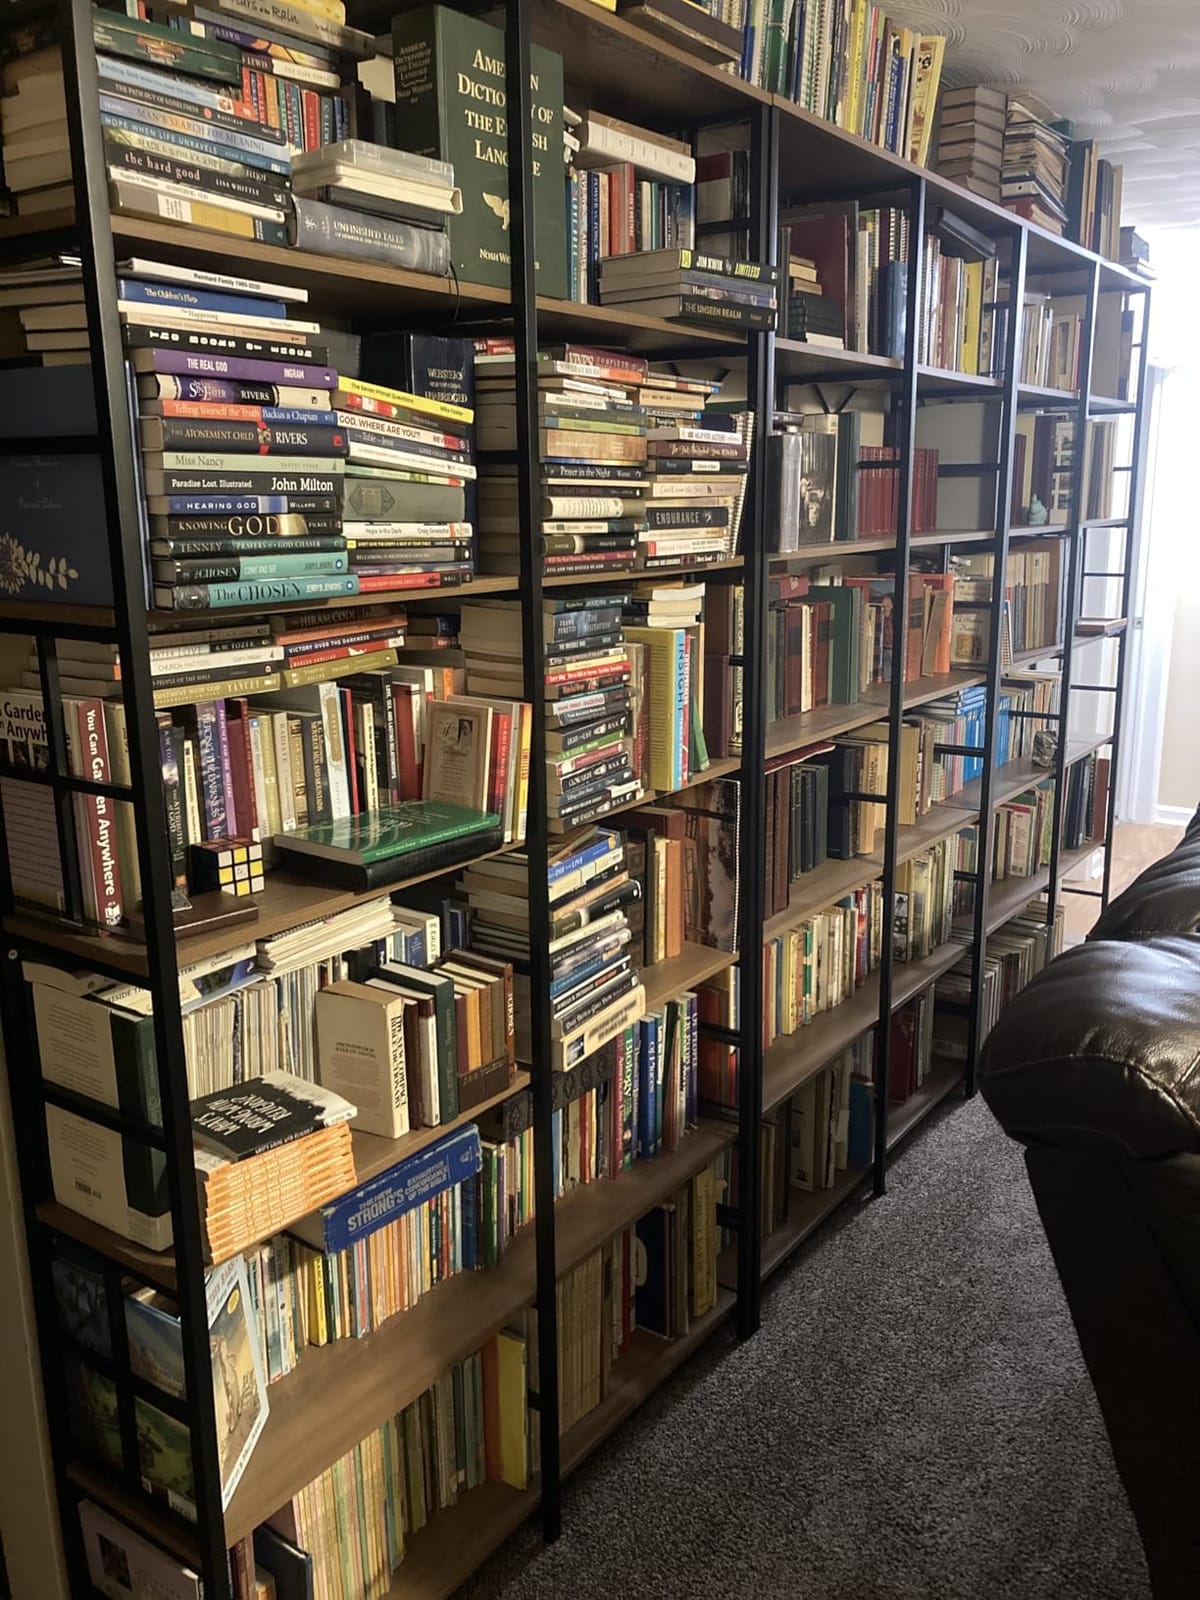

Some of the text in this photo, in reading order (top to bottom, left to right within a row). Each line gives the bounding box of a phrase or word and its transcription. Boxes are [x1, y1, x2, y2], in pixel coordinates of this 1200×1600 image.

[464, 109, 494, 134] THE
[105, 113, 218, 156] HOPE WHEN LIFE UNRAVELS
[226, 130, 265, 151] MEANING
[124, 151, 143, 167] the
[146, 156, 172, 173] hard
[175, 166, 201, 182] good
[215, 178, 230, 188] LISA
[696, 255, 708, 268] JIM
[734, 262, 761, 289] LIMITLESS
[217, 277, 234, 290] Family
[685, 302, 743, 320] THE UNSEEN REALM
[187, 357, 305, 384] THE REAL GOD INGRAM
[240, 389, 270, 402] RIVERS
[351, 383, 360, 391] The
[360, 385, 377, 394] Seven
[174, 404, 200, 418] Telling
[200, 407, 229, 420] Yourself
[229, 409, 241, 418] the
[241, 407, 261, 420] Truth
[262, 409, 287, 422] Backus
[358, 419, 386, 432] WHERE
[386, 424, 402, 434] ARE
[184, 429, 232, 443] ATONEMENT
[232, 431, 255, 444] CHILD
[275, 432, 308, 449] RIVERS
[174, 454, 226, 472] Miss Nancy
[560, 466, 579, 477] Prayer
[595, 468, 611, 478] Night
[171, 475, 335, 496] Paradise John Milton
[186, 502, 233, 510] HEARING
[177, 514, 281, 537] KNOWING GOD
[655, 511, 700, 525] ENDURANCE
[180, 542, 223, 553] TENNEY
[277, 541, 293, 549] GOD
[199, 564, 238, 579] CHOSEN
[214, 583, 301, 602] The CHOSEN
[288, 635, 370, 655] VICTORY OVER THE DARKNESS
[677, 643, 685, 712] INSIGHT
[4, 702, 45, 724] Garde
[86, 709, 115, 896] You Can Anywhere
[168, 811, 176, 833] GOD
[623, 1037, 633, 1098] Biology
[404, 1167, 447, 1196] CONCORDANCE
[406, 1160, 444, 1187] EXHAUSTIVE
[408, 1173, 447, 1202] OF THE BIBLE
[347, 1188, 405, 1231] STRONG'S
